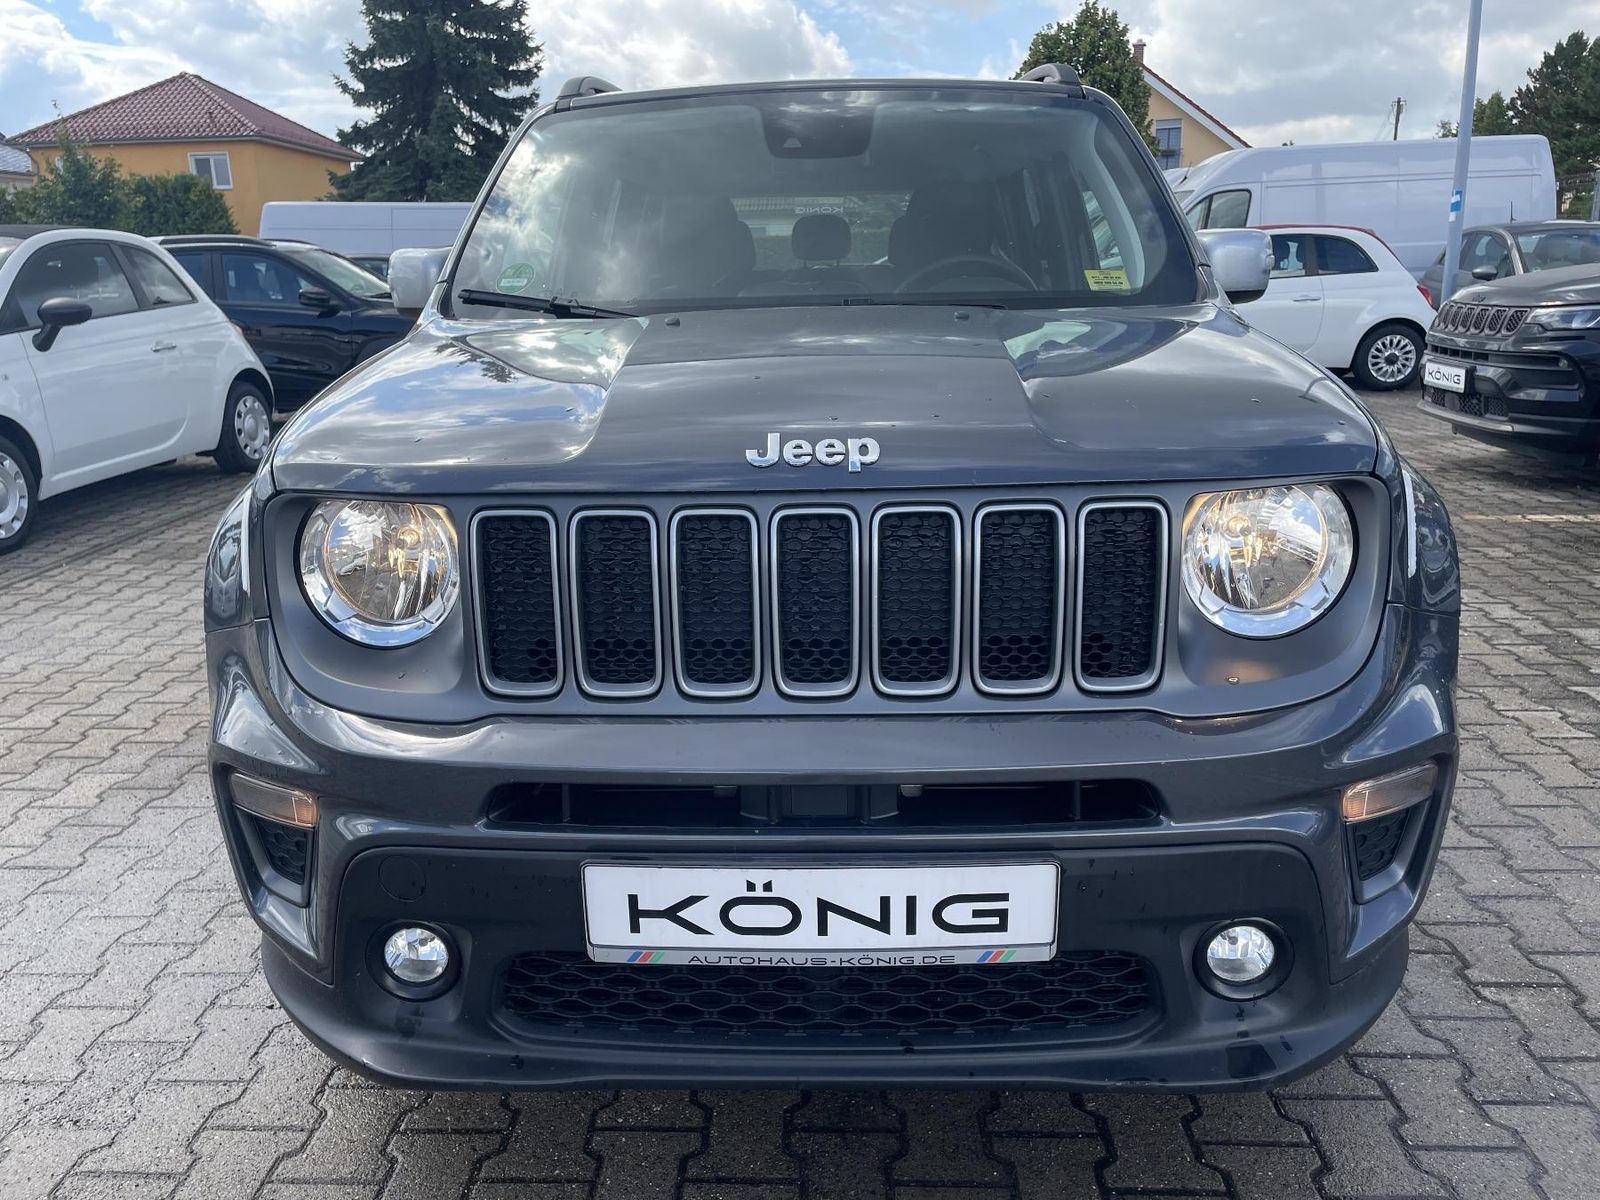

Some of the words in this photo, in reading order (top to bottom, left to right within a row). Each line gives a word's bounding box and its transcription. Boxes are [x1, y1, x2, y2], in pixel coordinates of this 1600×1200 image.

[1427, 367, 1462, 385] KÖNIG
[745, 432, 881, 472] Jeep
[627, 879, 1010, 937] KÖNIG
[688, 954, 956, 966] AUTOHAUS-KÖNIG.DE
